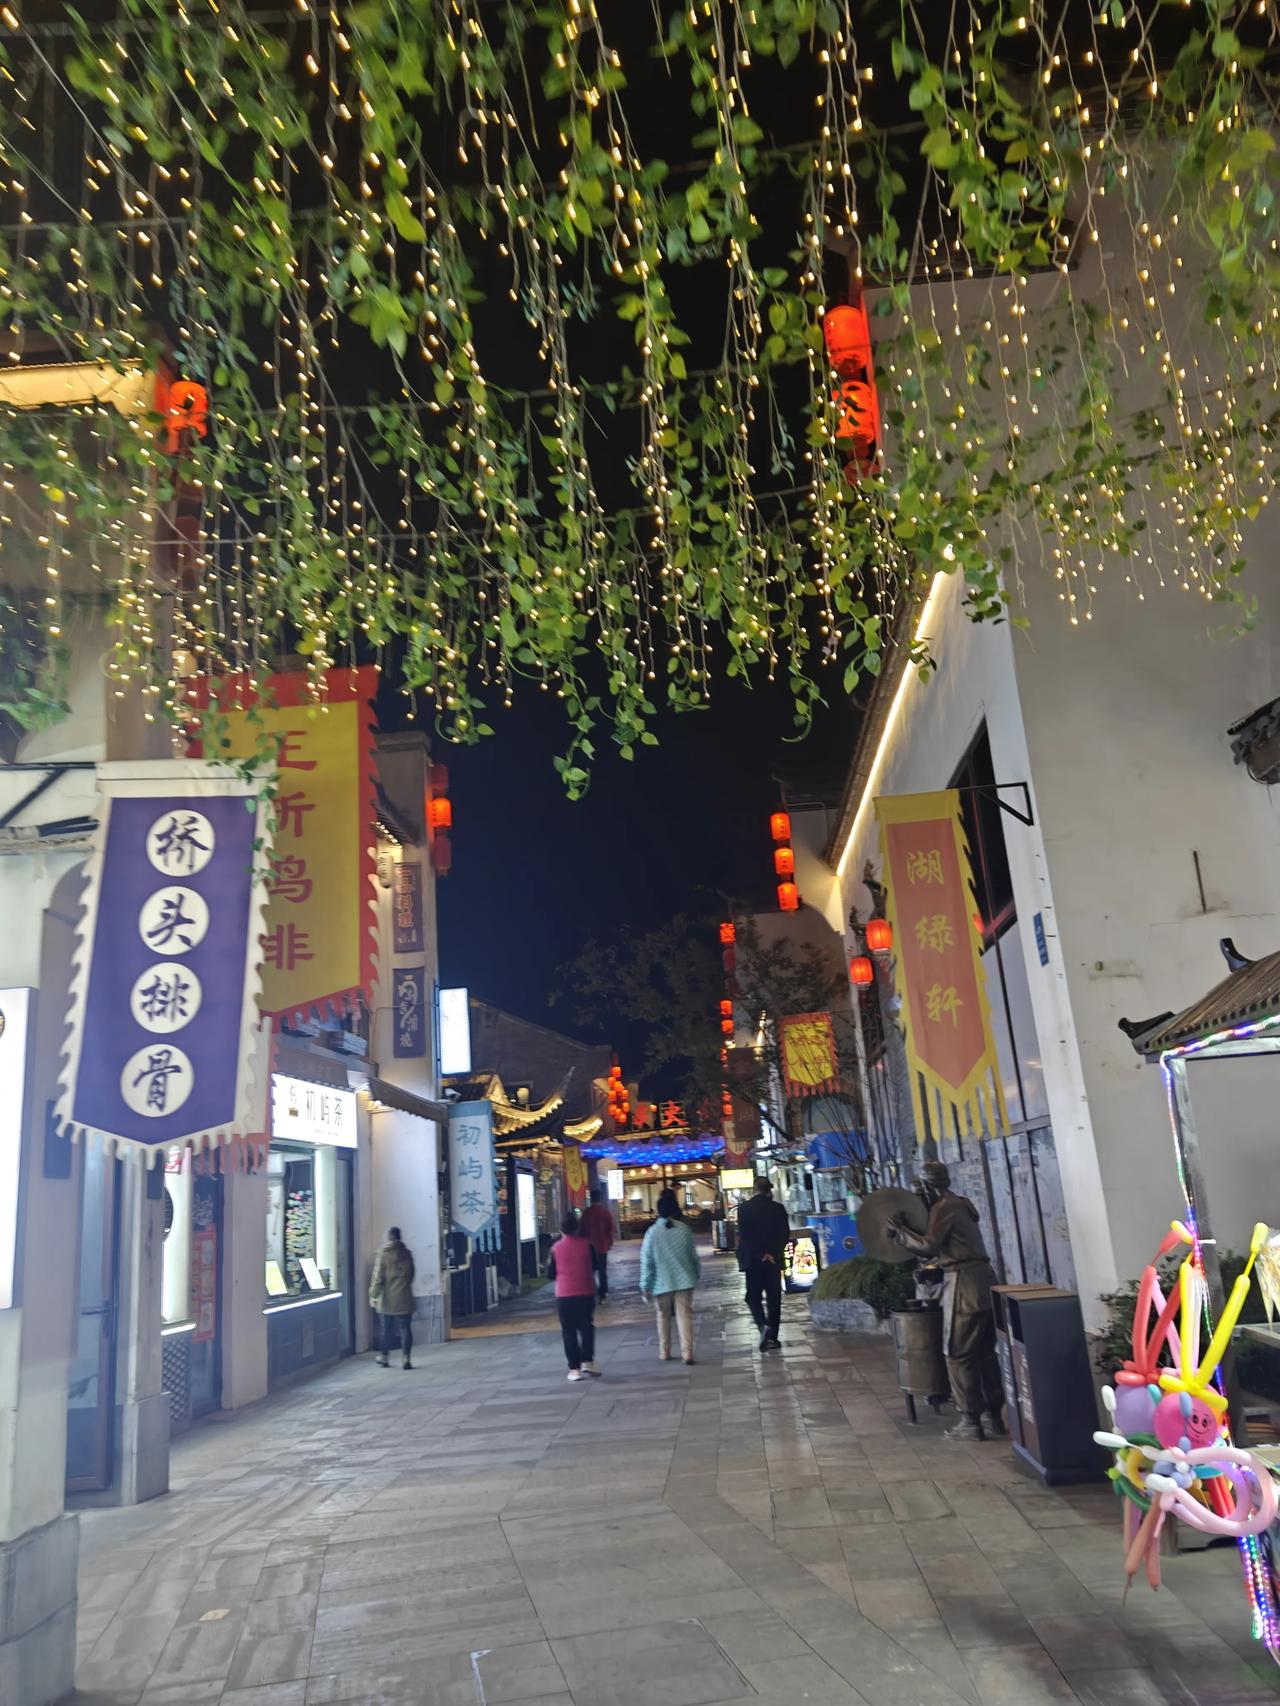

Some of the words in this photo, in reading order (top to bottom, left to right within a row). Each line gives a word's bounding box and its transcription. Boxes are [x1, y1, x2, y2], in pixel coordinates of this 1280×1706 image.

[132, 815, 210, 1112] 桥头排骨
[906, 849, 964, 1028] 湖绿轩
[456, 1124, 485, 1215] 初屿茶
